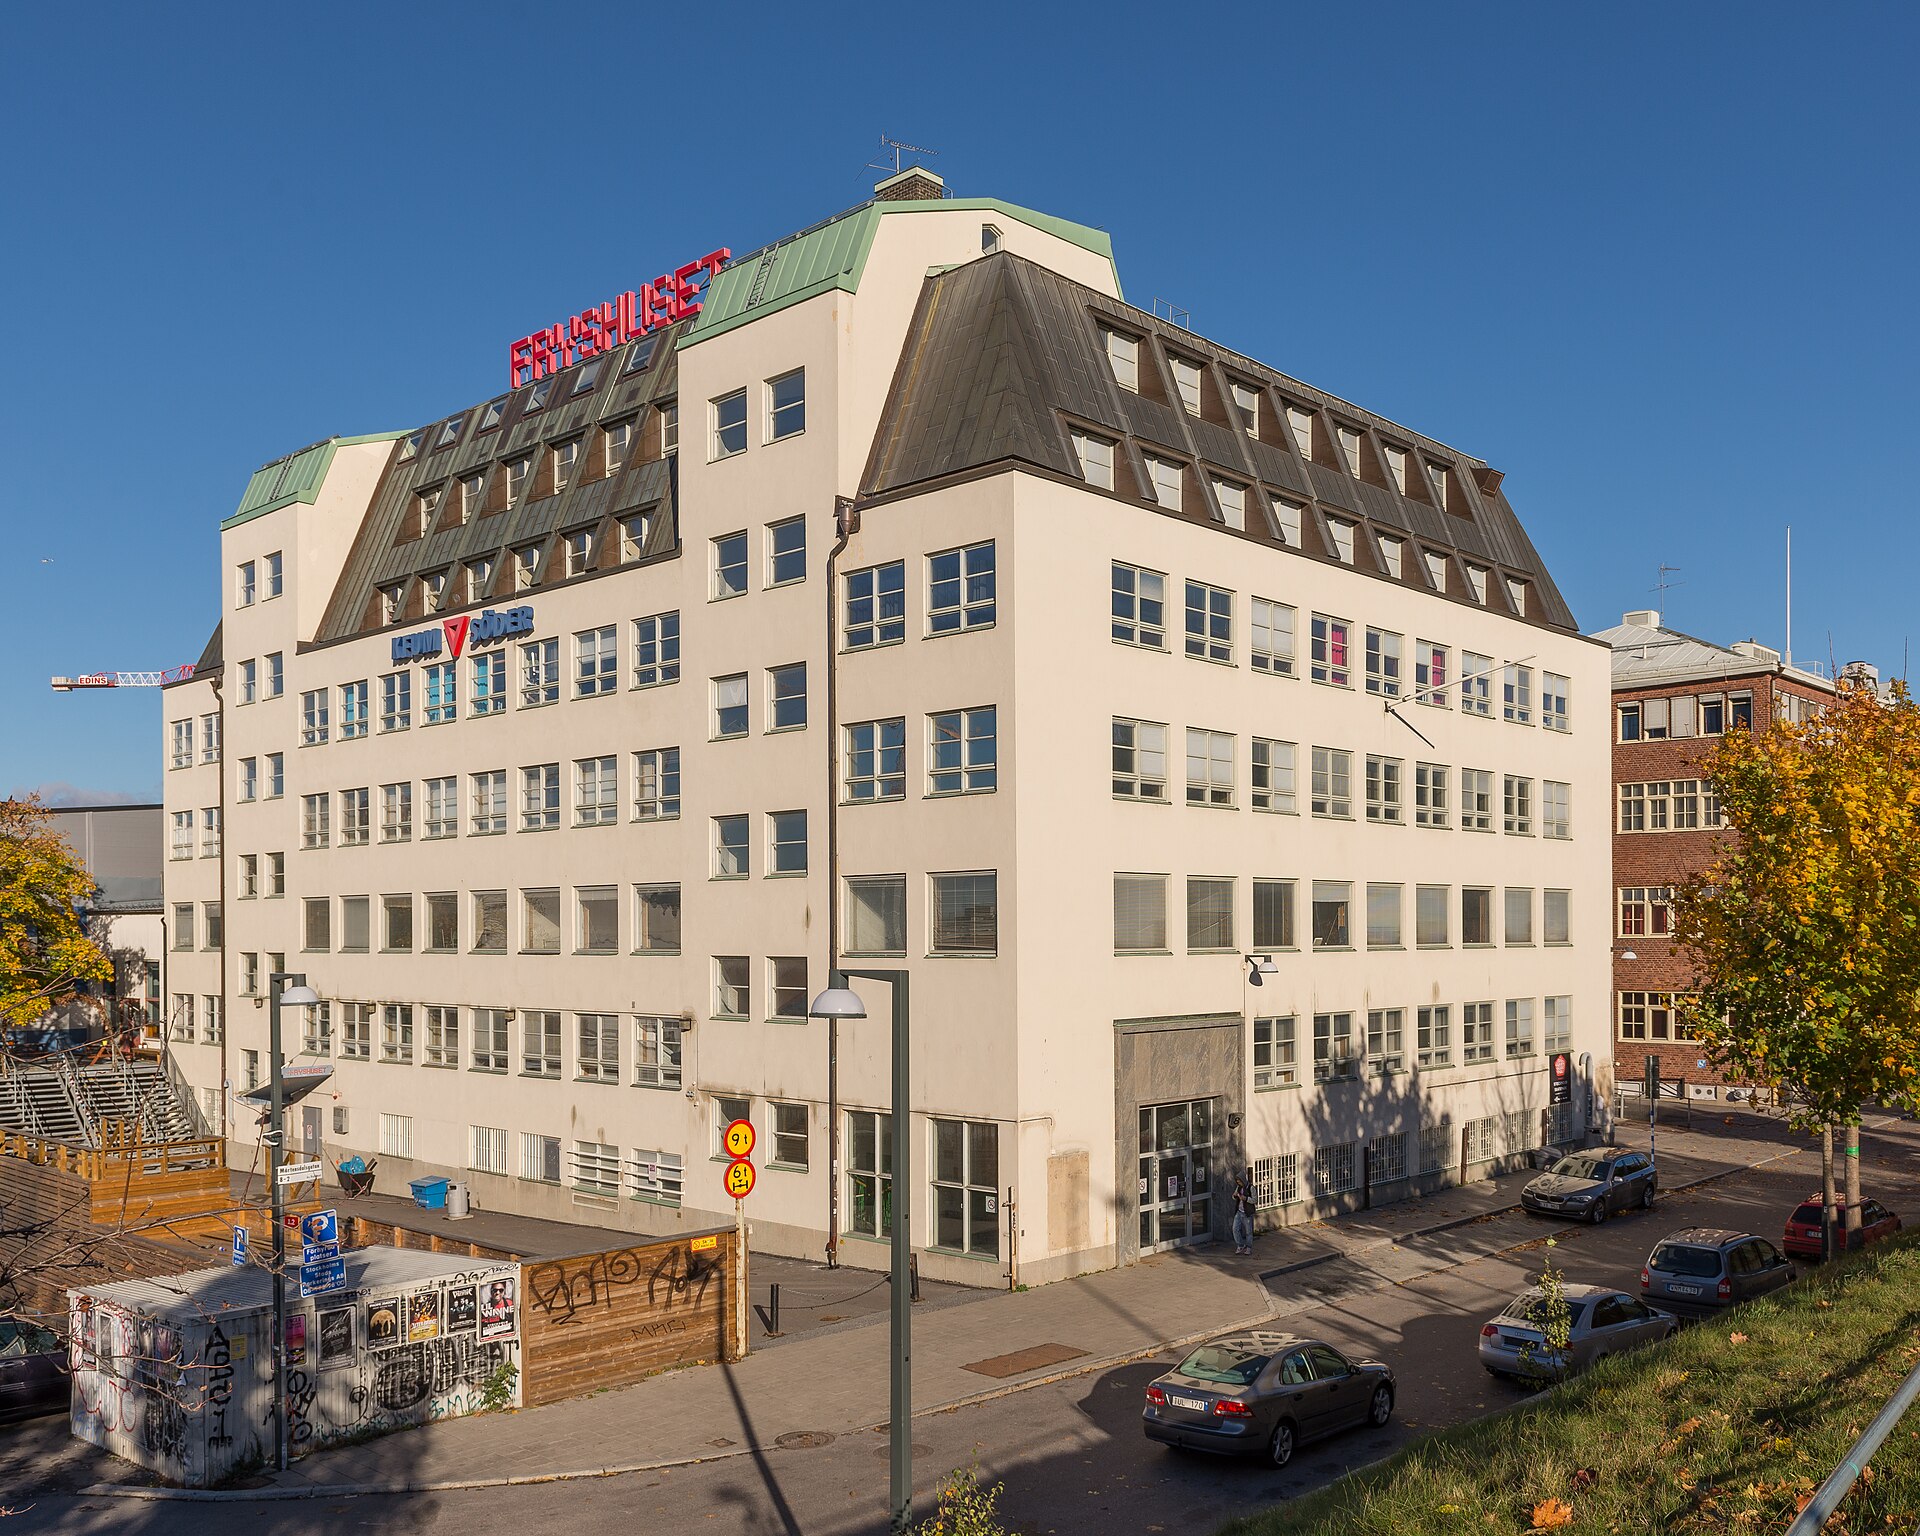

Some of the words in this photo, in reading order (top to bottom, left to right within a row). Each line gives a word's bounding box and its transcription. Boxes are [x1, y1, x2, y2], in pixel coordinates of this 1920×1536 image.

[510, 247, 731, 389] FRYSHUSET
[391, 628, 443, 661] KFUM
[470, 605, 535, 643] SÖDER
[79, 676, 107, 685] EDINS
[731, 1133, 740, 1147] 9
[743, 1133, 748, 1145] t
[733, 1165, 741, 1179] 6
[743, 1166, 747, 1177] t
[312, 1215, 328, 1242] P
[309, 1251, 333, 1263] platser
[305, 1262, 339, 1273] Stockholms
[335, 1272, 344, 1281] AB
[481, 1302, 493, 1311] LIL
[482, 1305, 515, 1320] WAYNE
[1174, 1398, 1185, 1406] TUL
[1191, 1400, 1203, 1409] 170
